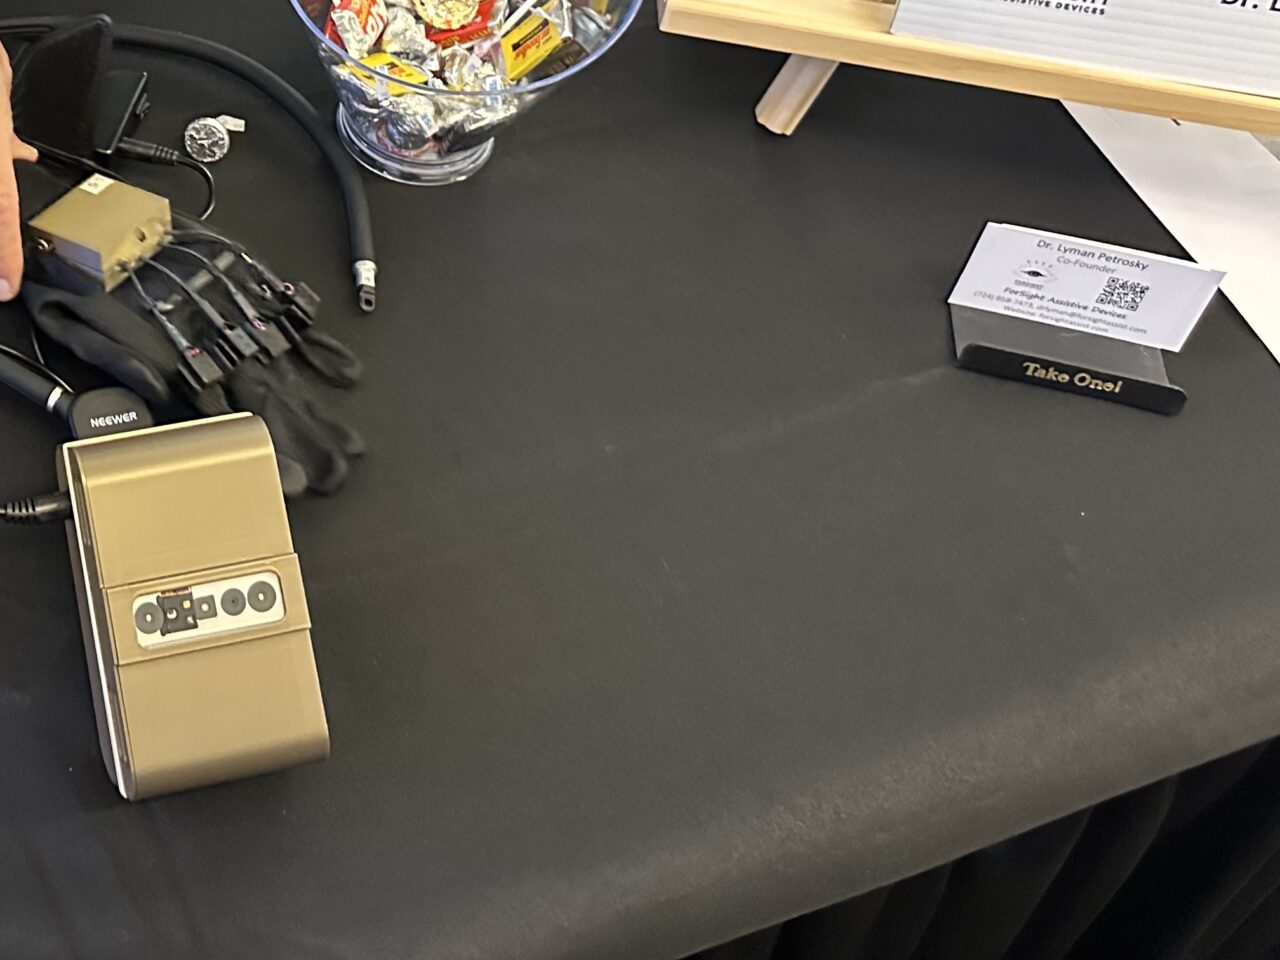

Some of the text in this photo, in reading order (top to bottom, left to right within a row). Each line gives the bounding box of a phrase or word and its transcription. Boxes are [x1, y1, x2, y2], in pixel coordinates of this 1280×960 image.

[1055, 2, 1105, 16] DEVICES
[1036, 239, 1149, 272] Dr. Lyman Petrosky
[1056, 256, 1117, 274] Co-Founder
[1003, 287, 1127, 320] ForSight Assistive Devices
[1022, 361, 1123, 393] Take One!
[90, 411, 138, 428] NEEWER
